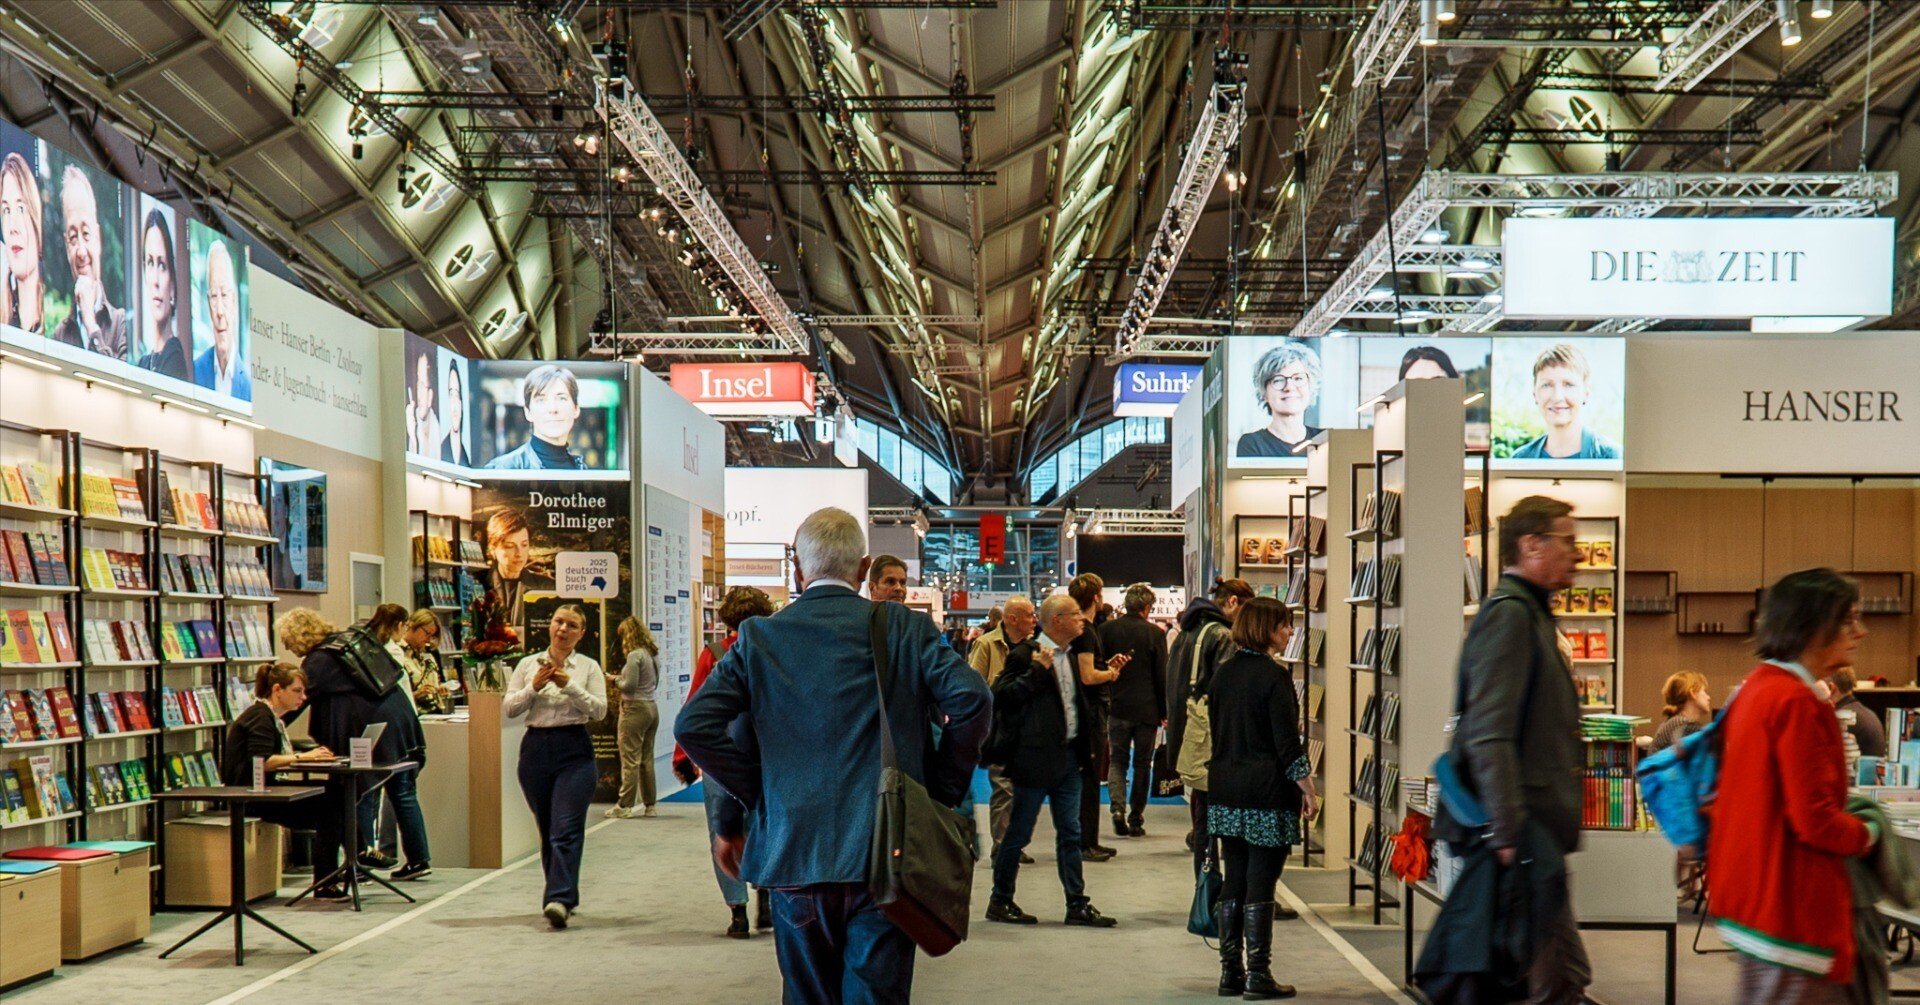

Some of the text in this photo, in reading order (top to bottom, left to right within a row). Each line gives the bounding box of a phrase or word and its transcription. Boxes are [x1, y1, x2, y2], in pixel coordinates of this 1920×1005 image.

[1590, 250, 1808, 282] DIE ZEIT
[281, 321, 308, 354] Hanser
[309, 334, 331, 364] Berlin
[699, 367, 774, 398] Insel
[1742, 390, 1903, 422] HANSER
[529, 491, 607, 508] Dorothee
[547, 512, 615, 532] Elmiger
[985, 536, 998, 556] E
[565, 566, 608, 575] deutscher
[589, 558, 608, 567] 2025
[565, 575, 587, 583] buch
[565, 583, 587, 592] preis
